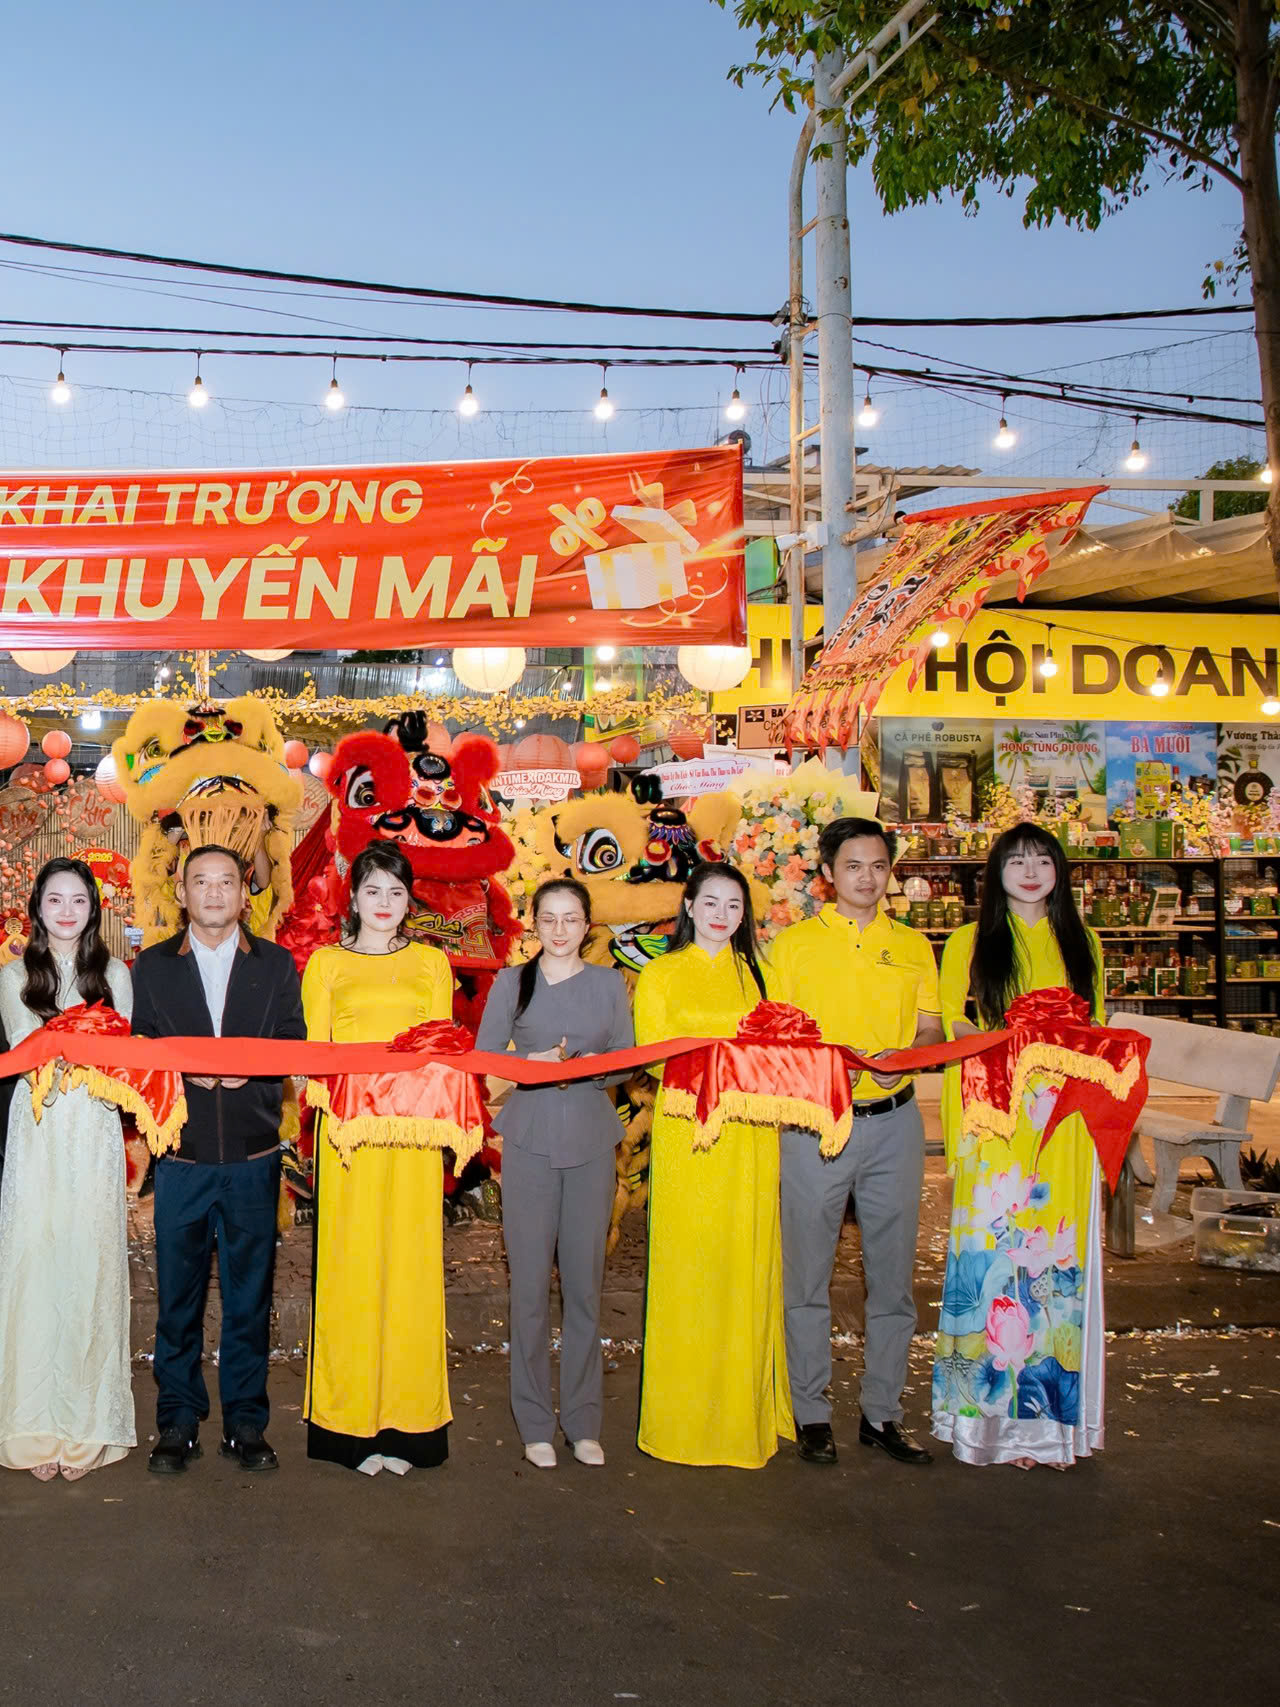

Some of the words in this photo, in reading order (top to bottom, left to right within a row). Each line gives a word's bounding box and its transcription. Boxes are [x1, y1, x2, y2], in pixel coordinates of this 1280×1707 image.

[157, 478, 424, 525] TRƯƠNG
[1, 536, 357, 622] KHUYẾN
[374, 536, 540, 619] MÃI
[924, 629, 1047, 707] HỘI
[934, 733, 982, 743] ROBUSTA
